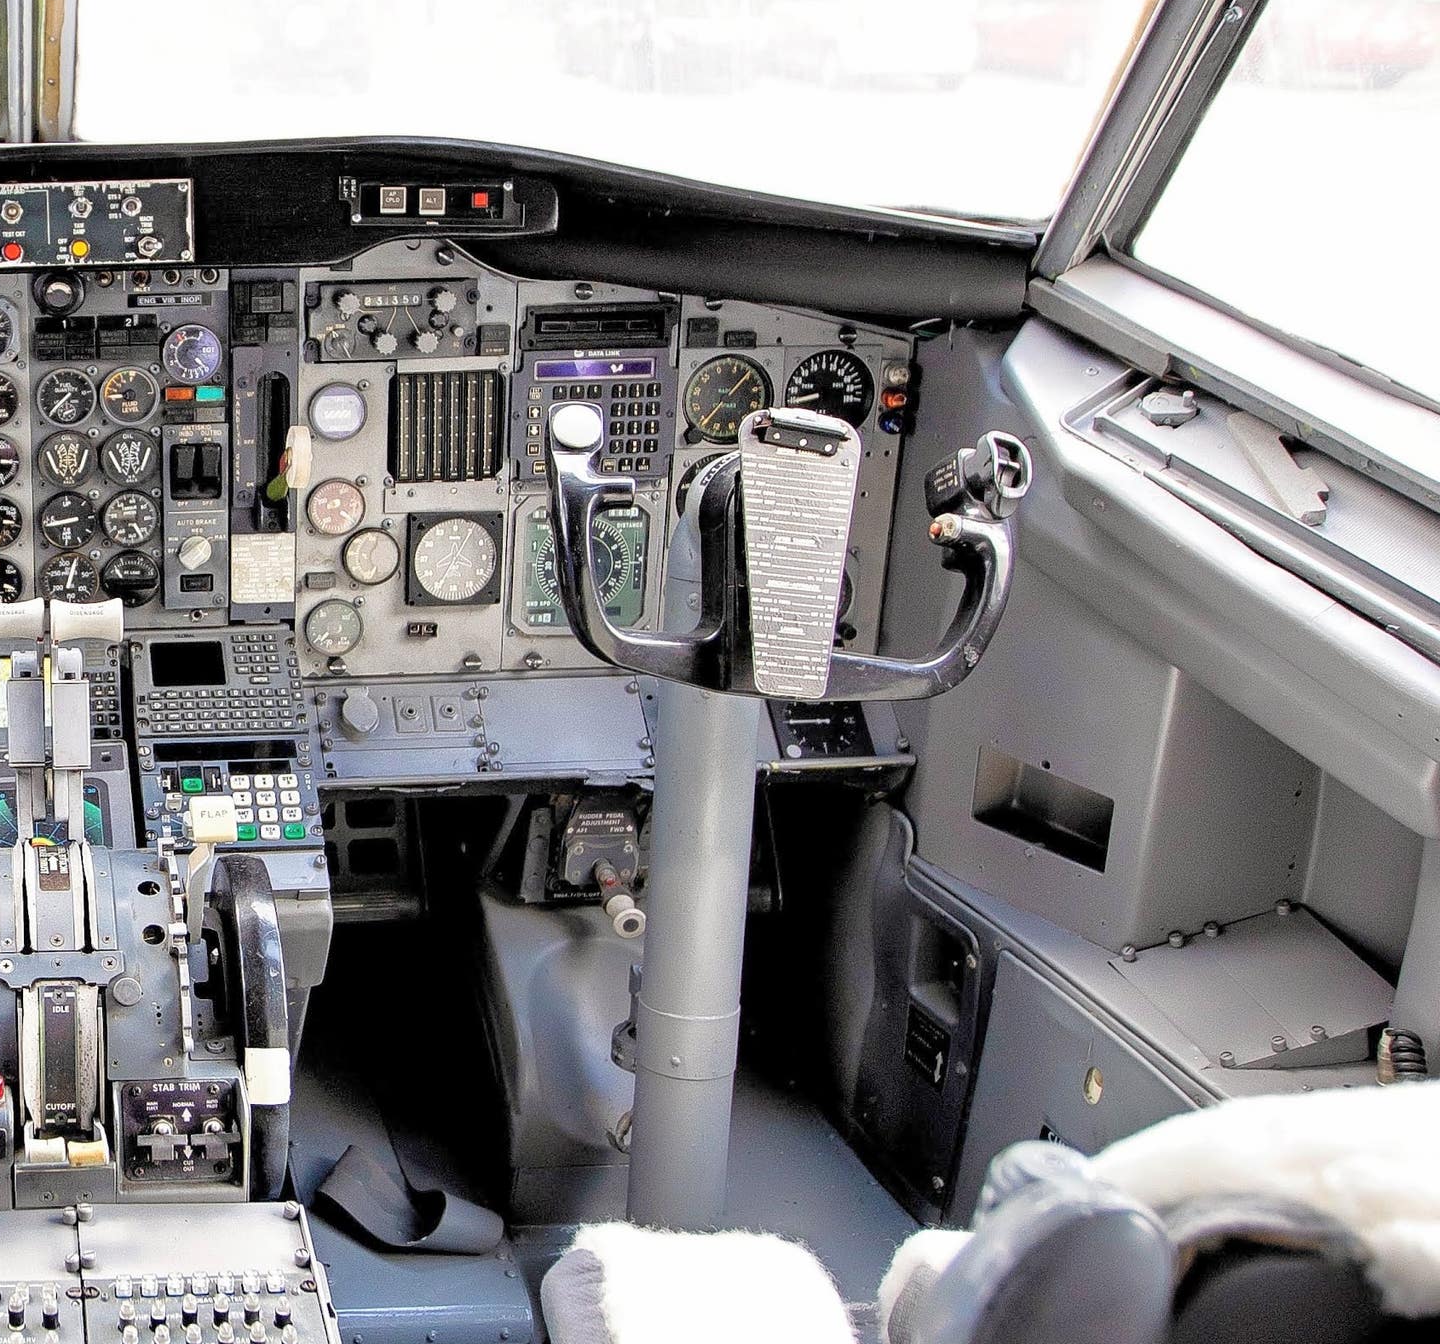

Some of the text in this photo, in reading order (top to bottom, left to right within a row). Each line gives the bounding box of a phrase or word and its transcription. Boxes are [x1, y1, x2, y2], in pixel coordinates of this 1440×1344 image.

[138, 295, 201, 305] ENG VIB INOP
[193, 518, 218, 526] BRAKE
[200, 809, 229, 818] FLAP
[52, 1005, 70, 1014] IDLE
[152, 1082, 201, 1093] STAB TRIM
[45, 1102, 76, 1112] CUTOFF
